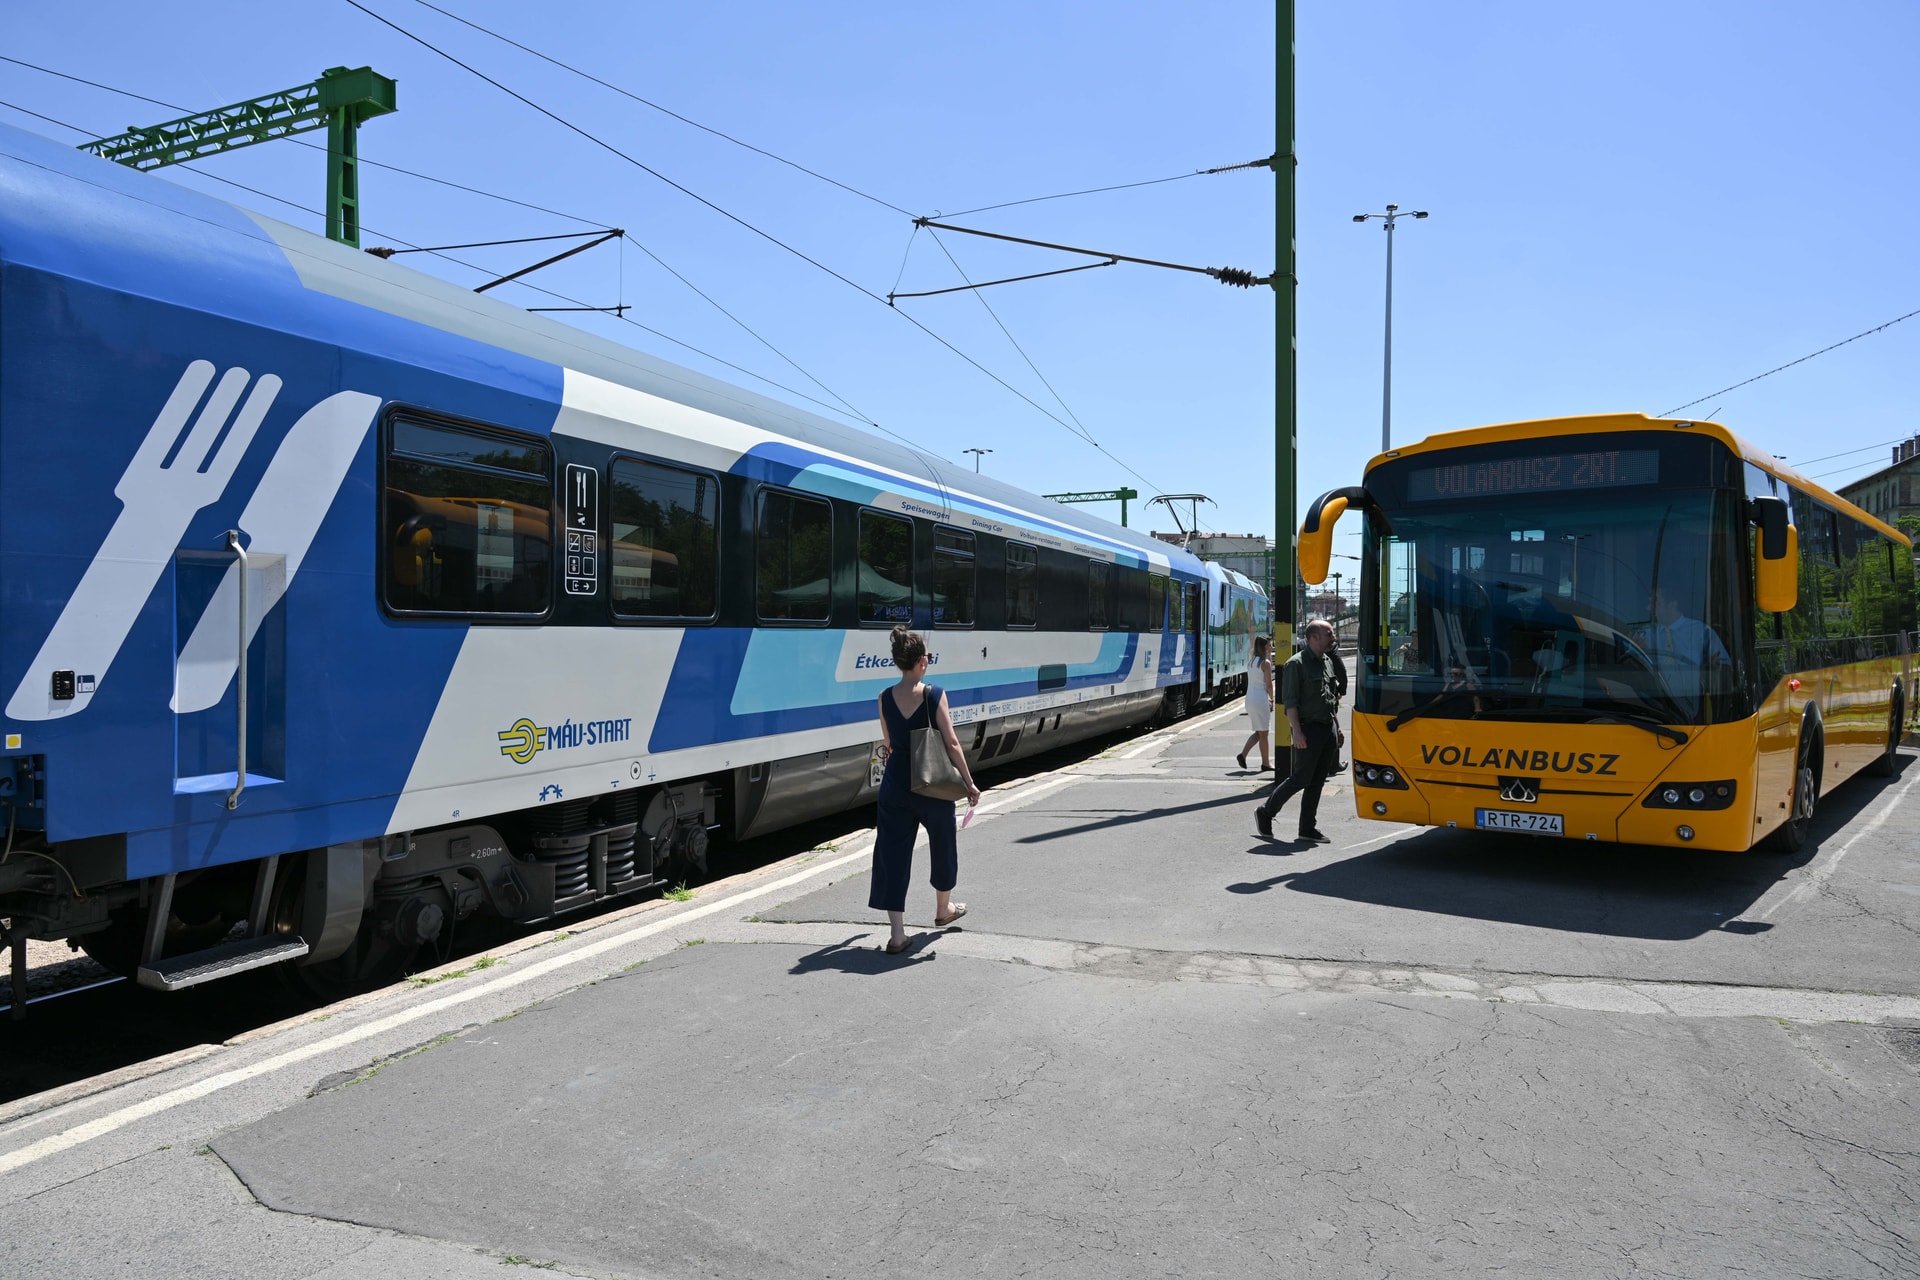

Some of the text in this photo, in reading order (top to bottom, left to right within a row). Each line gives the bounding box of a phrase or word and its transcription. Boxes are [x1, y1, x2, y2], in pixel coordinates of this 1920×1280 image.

[1573, 451, 1626, 484] ZRT.
[901, 501, 950, 520] Speisewagen
[971, 519, 1003, 533] Dining Car
[547, 718, 632, 750] MÁV-START
[1421, 744, 1620, 776] VOLÁNBUSZ
[452, 809, 460, 818] 4R
[1487, 811, 1559, 832] RTR-724
[476, 848, 498, 859] 2.60m
